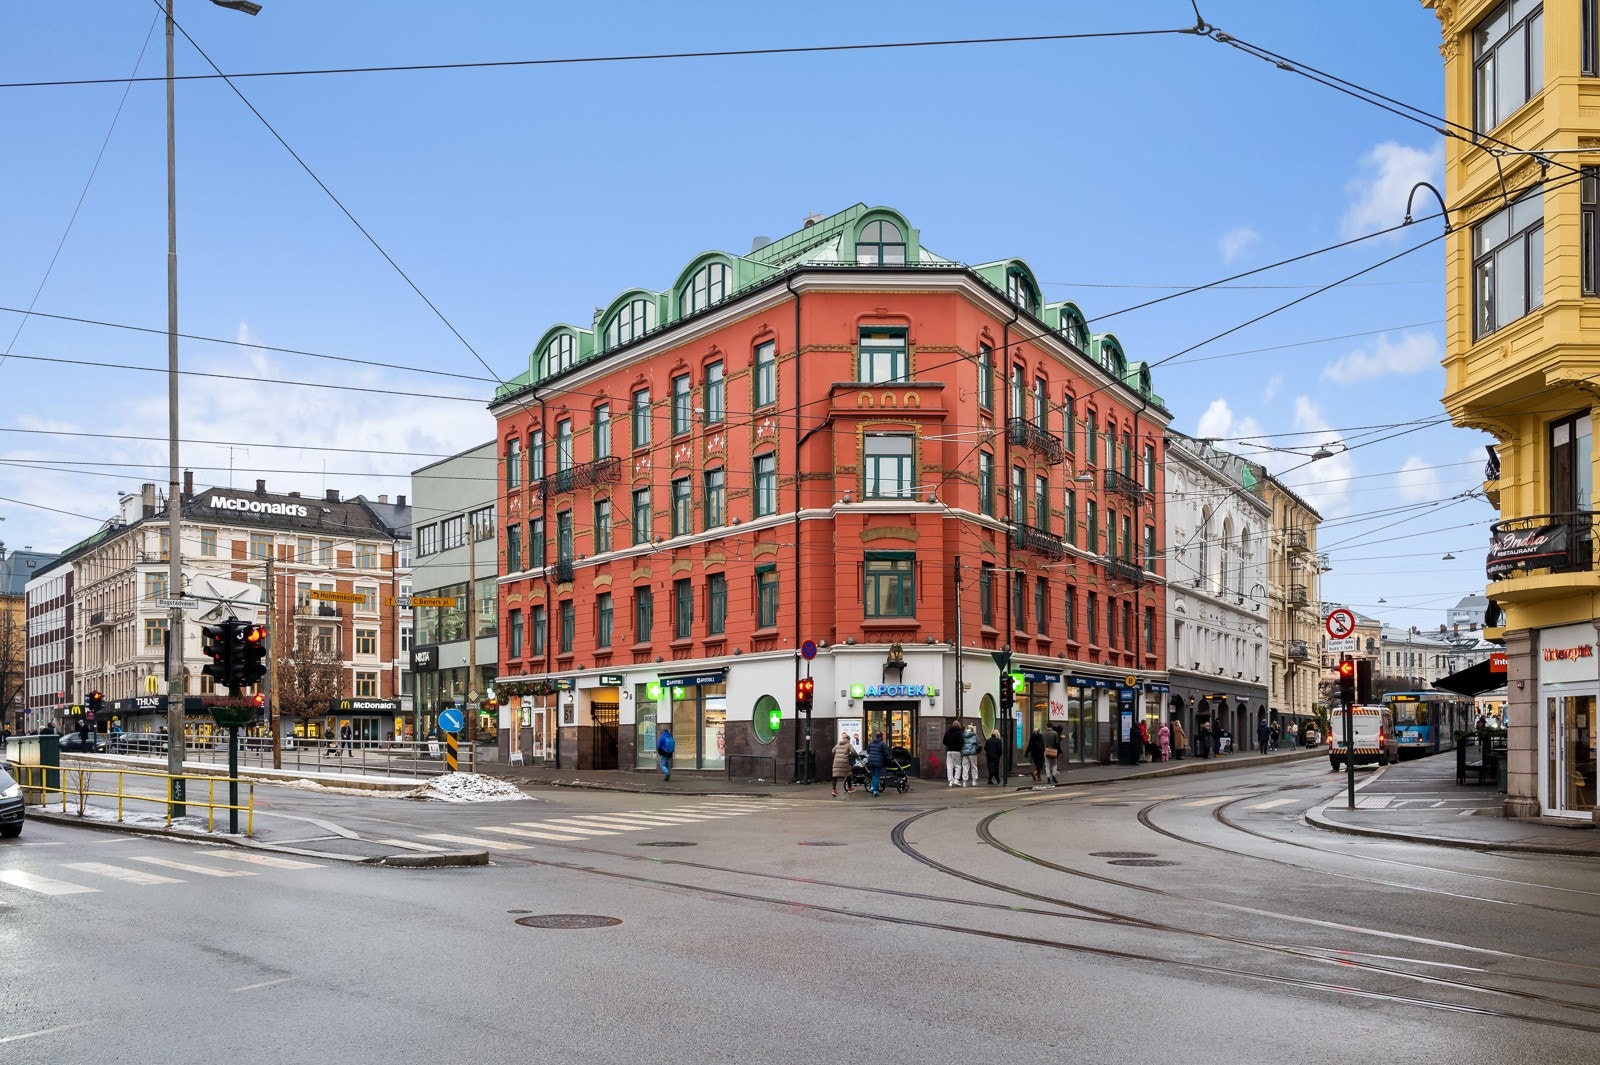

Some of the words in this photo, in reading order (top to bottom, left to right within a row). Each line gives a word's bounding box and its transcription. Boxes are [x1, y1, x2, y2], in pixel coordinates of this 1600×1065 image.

[210, 495, 308, 517] McDonald's
[1502, 531, 1549, 550] India
[1497, 546, 1538, 557] RESTAURANT
[320, 592, 363, 602] Holmenkollen
[159, 599, 196, 607] Bogstadveien
[867, 684, 925, 698] APOTEK
[926, 684, 936, 698] 1
[135, 697, 160, 706] THUNE
[564, 709, 573, 721] 51
